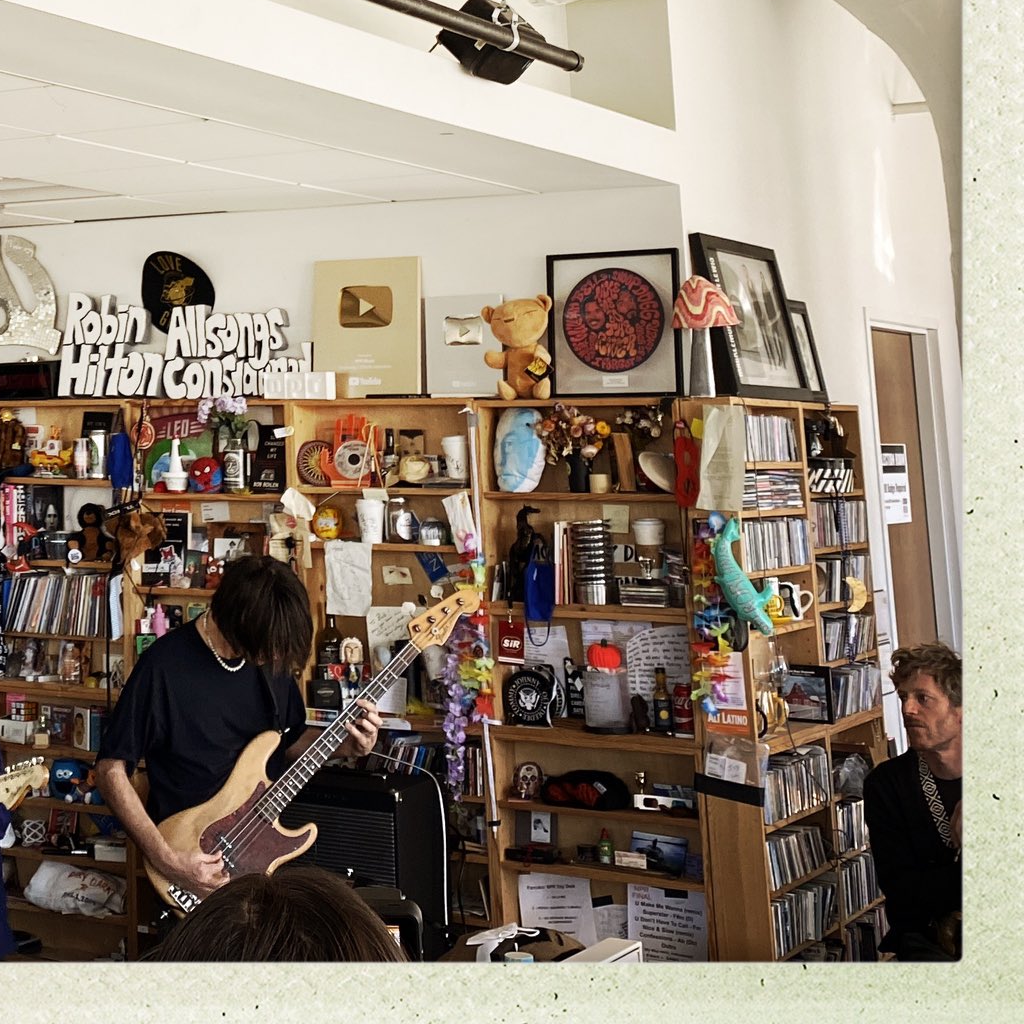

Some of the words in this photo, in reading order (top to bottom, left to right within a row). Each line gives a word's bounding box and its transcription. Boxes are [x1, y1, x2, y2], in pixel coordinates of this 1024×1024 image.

[151, 257, 183, 274] LOVE
[63, 293, 147, 345] Robin
[164, 305, 286, 370] Allsongs
[57, 342, 163, 397] Hilton
[502, 638, 521, 649] SiR
[514, 676, 540, 688] JOHNNY
[722, 712, 747, 726] LATINO
